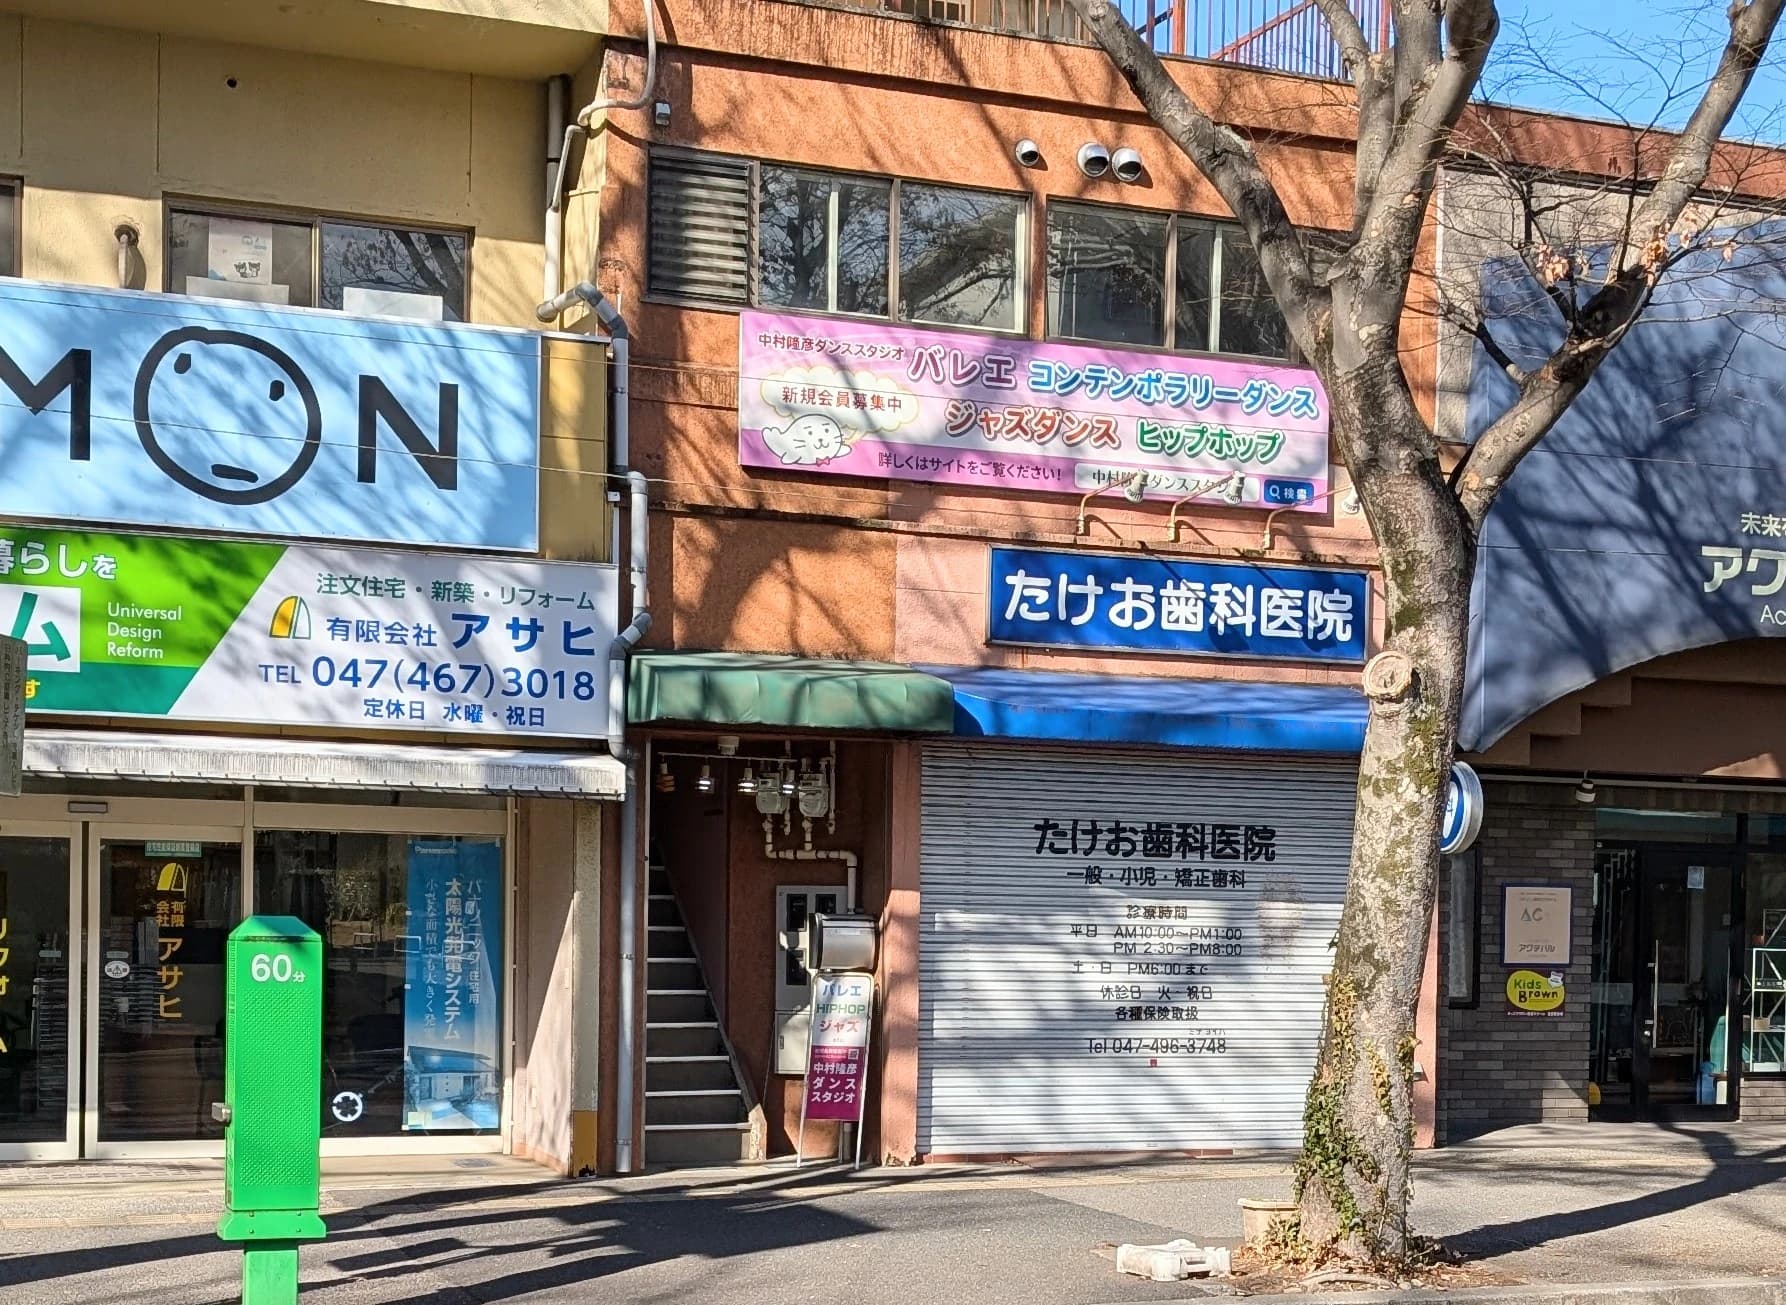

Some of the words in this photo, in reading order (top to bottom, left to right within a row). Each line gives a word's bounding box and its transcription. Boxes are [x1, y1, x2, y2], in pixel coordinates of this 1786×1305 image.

[759, 334, 904, 361] 中村隆彦ダンススタジオ
[908, 346, 1017, 388] バレエ
[1028, 361, 1319, 419] コンテンポラリーダンス
[782, 386, 902, 412] 新規会員募集中
[945, 400, 1121, 450] ジャズダンス
[1136, 418, 1286, 464] ヒップホップ
[1741, 512, 1786, 537] 未来
[108, 602, 182, 620] Universal
[1005, 570, 1353, 642] たけお歯科医院
[108, 622, 161, 641] Design
[326, 617, 437, 647] 有限会社
[451, 613, 596, 656] アサヒ
[108, 642, 163, 659] Reform
[259, 664, 301, 684] TEL
[312, 656, 596, 700] 047(467)3018
[363, 698, 425, 721] 定休日
[443, 703, 545, 727] 水曜・祝日
[1034, 818, 1276, 861] たけお歯科医院
[1066, 865, 1246, 888] 一般・小児・矯正歯科
[1127, 904, 1187, 920] 診療時間
[1070, 924, 1098, 938] 平日
[251, 953, 306, 983] 60分
[444, 878, 462, 1041] 太陽光発電システム
[157, 937, 184, 1018] アサヒ
[1514, 979, 1542, 990] Kids
[823, 984, 862, 997] バレエ
[1100, 984, 1141, 1000] 休診日
[1518, 990, 1558, 1003] Brown
[816, 1003, 865, 1015] HIPHOP
[1115, 1006, 1199, 1021] 各種保険取扱
[820, 1020, 859, 1033] ジャズ
[1087, 1038, 1107, 1054] Tel
[1112, 1038, 1226, 1054] 047-496-3748
[813, 1061, 857, 1075] 中村隆彦
[812, 1077, 856, 1090] ダンス
[811, 1091, 856, 1103] スタジオ
